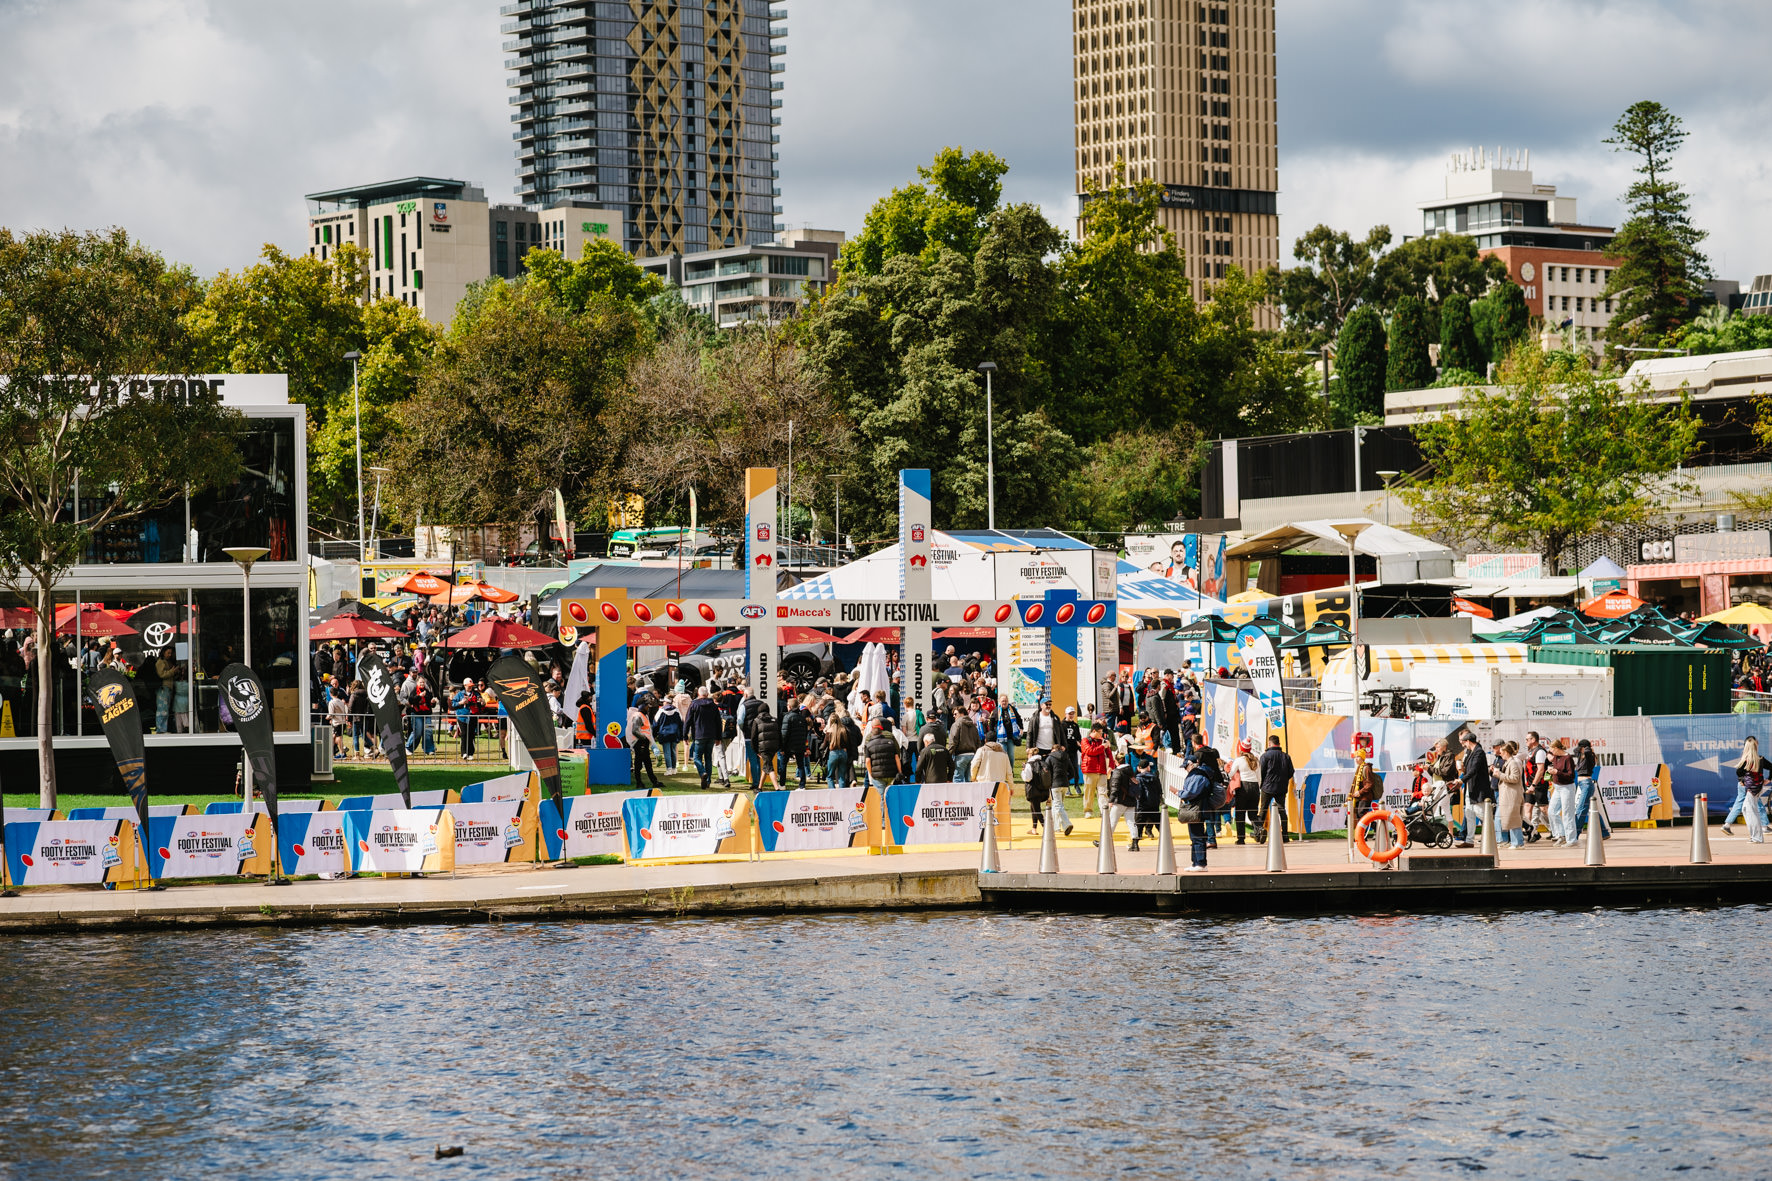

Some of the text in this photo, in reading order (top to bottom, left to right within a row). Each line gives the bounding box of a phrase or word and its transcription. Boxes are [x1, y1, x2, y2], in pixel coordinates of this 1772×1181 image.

[582, 222, 608, 236] scape
[1021, 567, 1067, 576] FOOTY FESTIVAL
[742, 607, 766, 616] AFL
[790, 608, 831, 617] Macca's
[841, 603, 940, 622] FOOTY FESTIVAL
[705, 654, 746, 668] TOYO
[1256, 657, 1275, 666] FREE
[1251, 668, 1275, 678] ENTRY
[515, 693, 538, 712] ADELAIDE
[102, 698, 134, 725] EAGLES
[1572, 738, 1606, 747] Mca's
[1684, 740, 1744, 751] ENTRANC
[1602, 786, 1643, 797] FOOTY FESTIVAL
[1386, 795, 1403, 805] FOOTY
[791, 812, 844, 823] FOOTY FESTIVAL
[922, 807, 974, 818] FOOTY FESTIVAL
[575, 819, 596, 830] FOOTY
[659, 818, 711, 831] FOOTY FESTIVAL
[469, 826, 499, 837] FESTIVAL
[312, 836, 333, 847] FOOTY
[375, 833, 418, 843] FOOTY FESTIVAL
[178, 838, 232, 850] FOOTY FESTIVAL
[41, 845, 96, 857] FOOTY FESTIVAL
